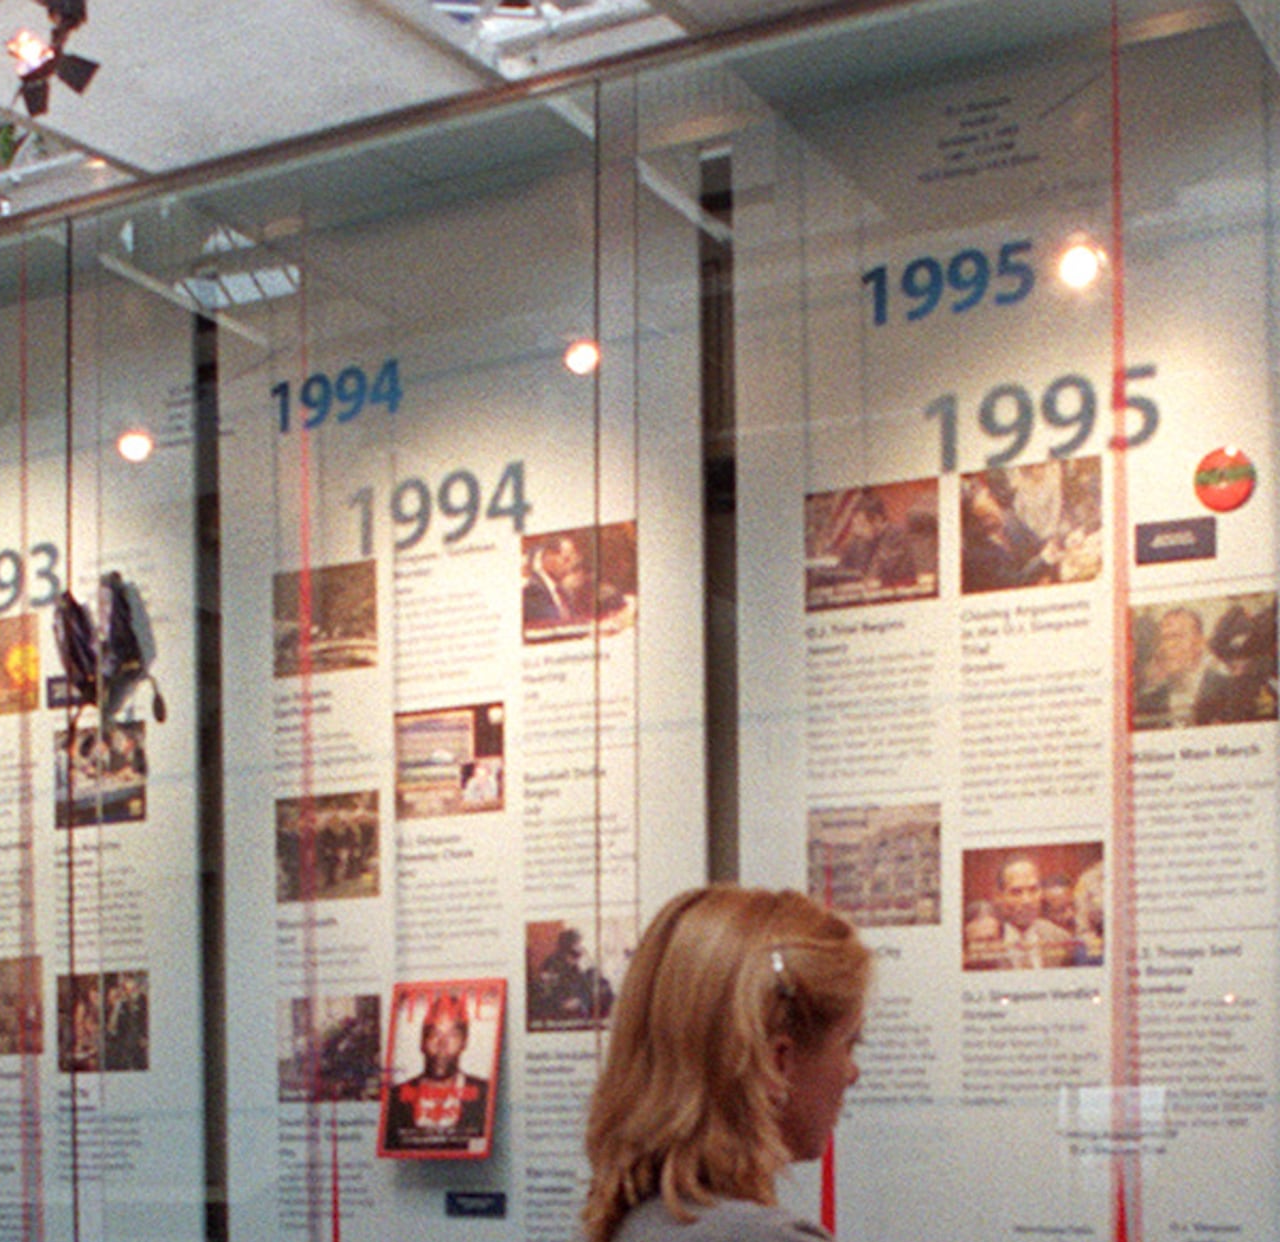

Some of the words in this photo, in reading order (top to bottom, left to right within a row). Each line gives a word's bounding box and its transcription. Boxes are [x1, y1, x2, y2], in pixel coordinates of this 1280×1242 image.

[861, 239, 1037, 327] 1995
[271, 357, 404, 434] 1994
[924, 363, 1161, 475] 1995
[348, 460, 533, 556] 1994
